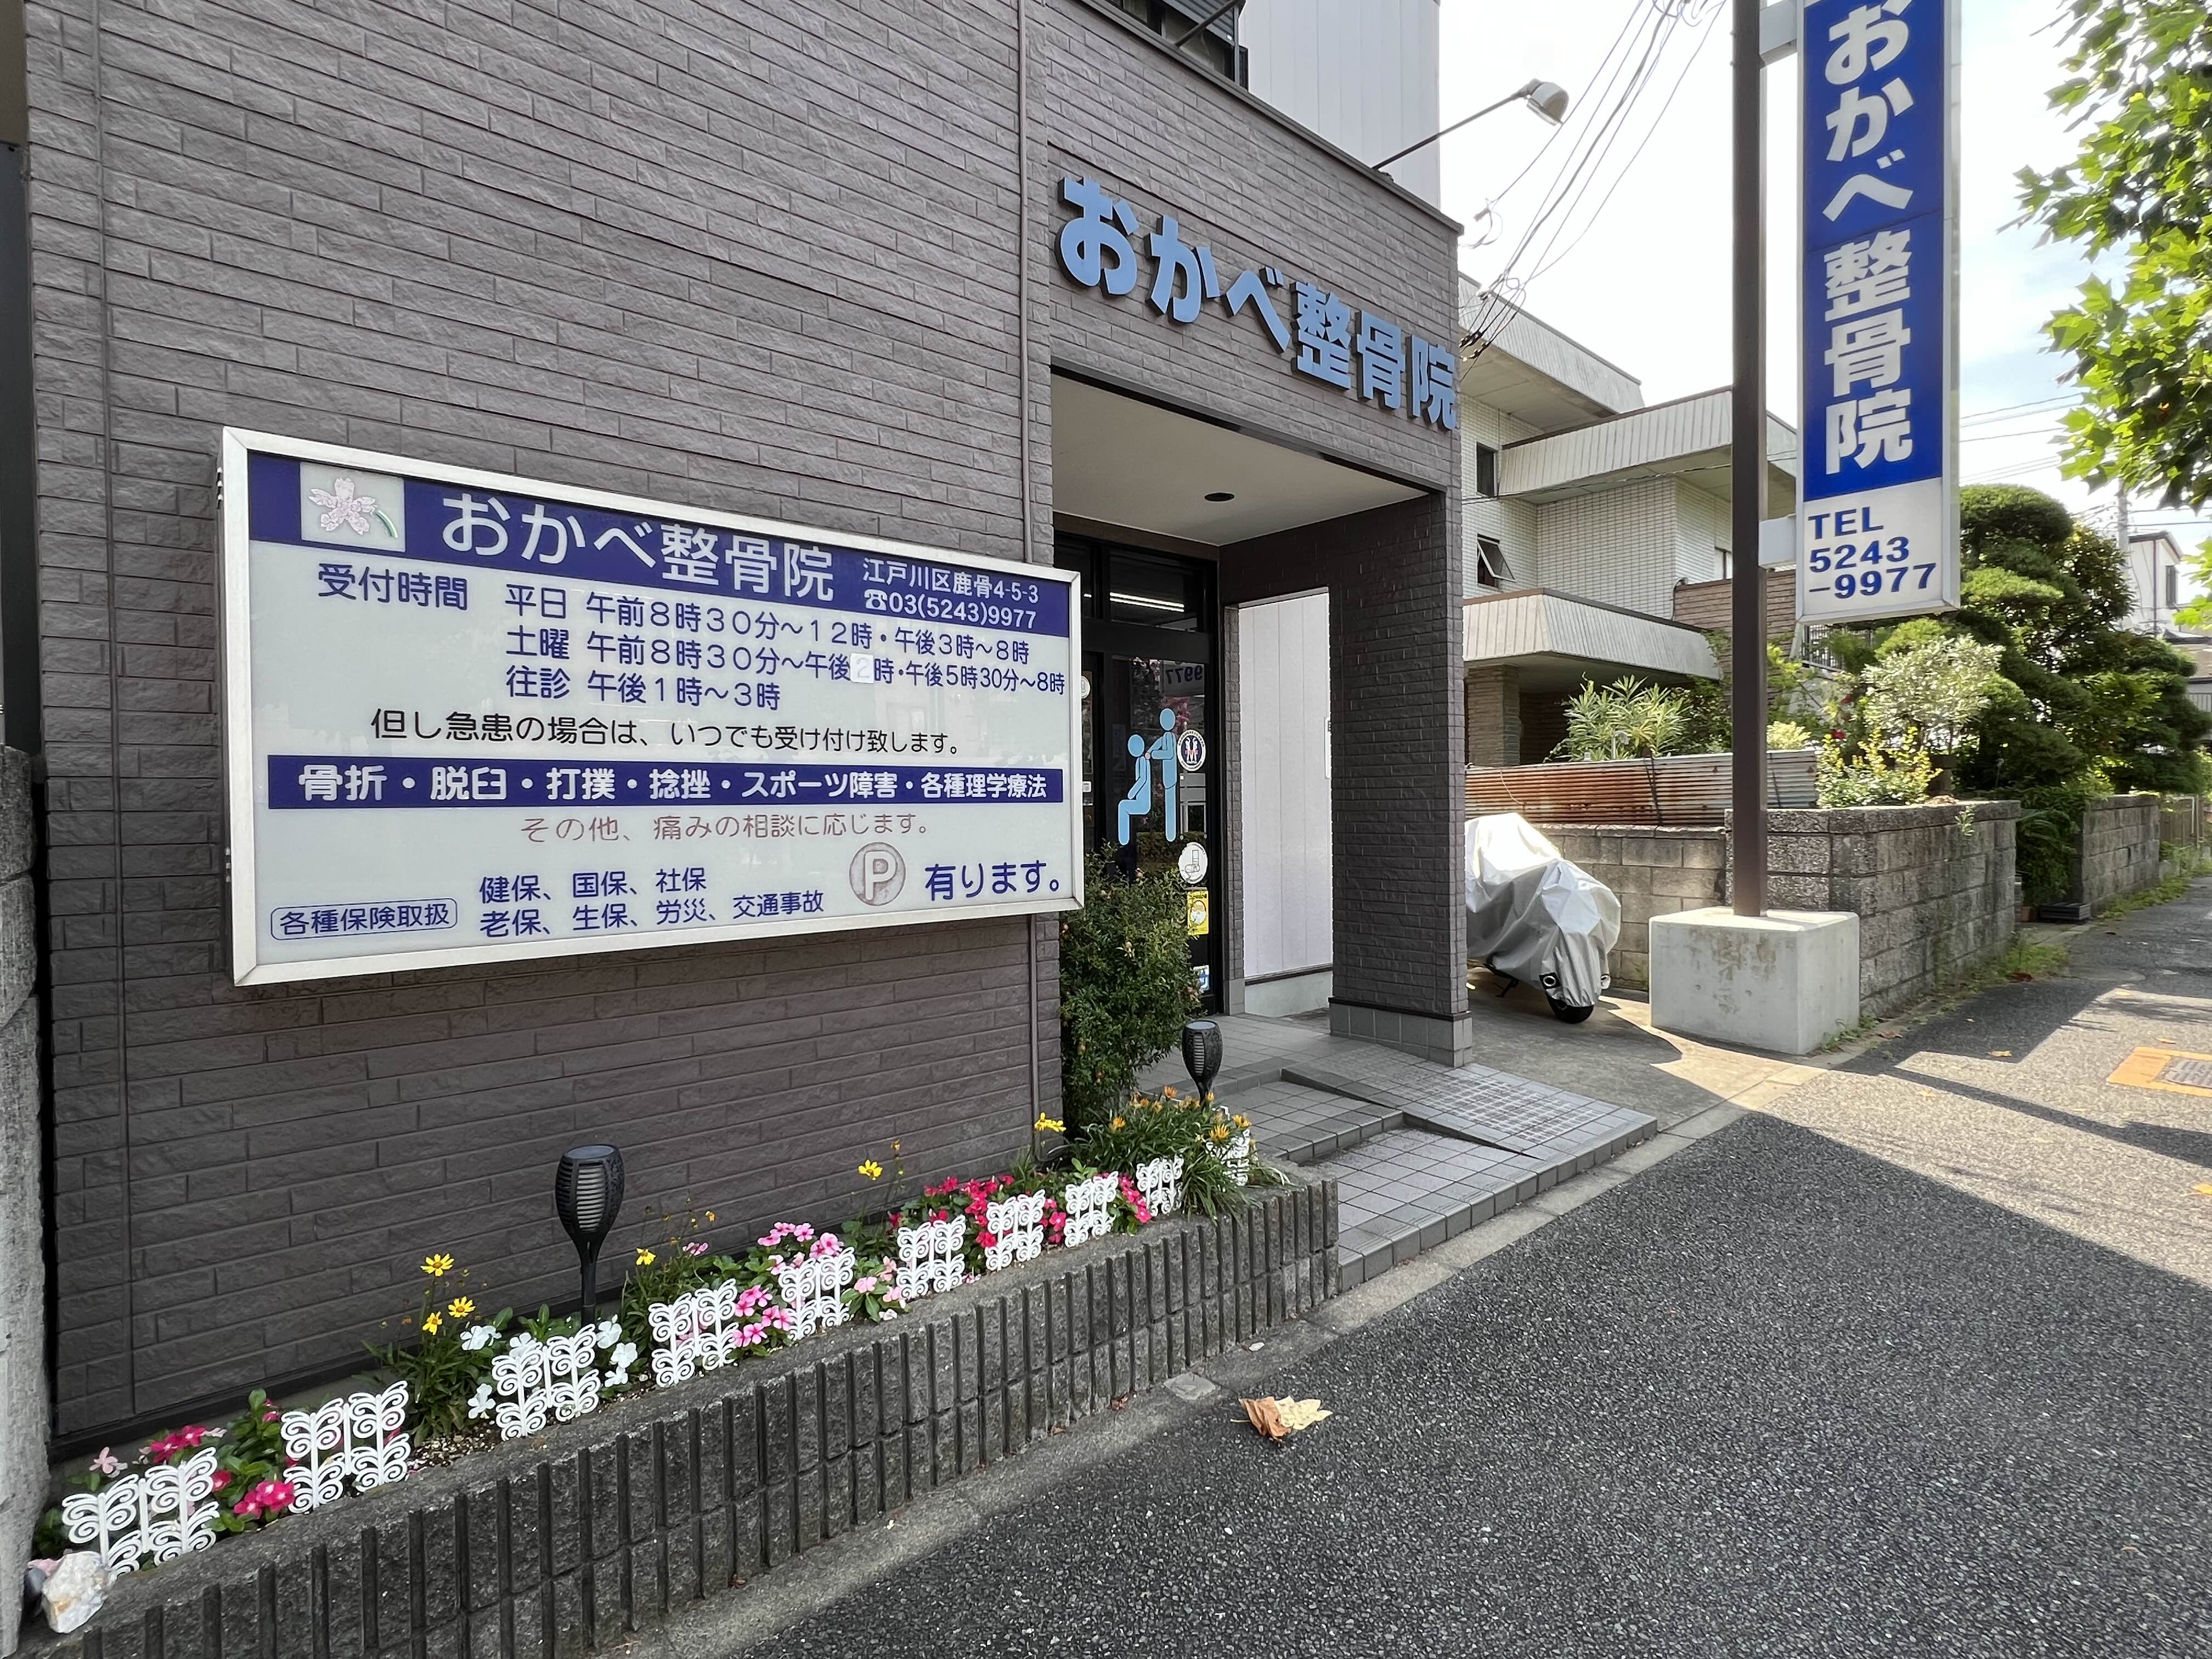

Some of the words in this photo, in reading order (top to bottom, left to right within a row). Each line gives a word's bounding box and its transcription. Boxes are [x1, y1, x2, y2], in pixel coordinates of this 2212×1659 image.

[1822, 0, 1914, 475] おかべ整骨院
[1055, 176, 1457, 431] おかべ整骨院
[1808, 506, 1883, 539] TEL
[442, 493, 833, 602] おかべ整骨院
[1809, 537, 1909, 573] 5243
[318, 563, 468, 610] 受付時間
[505, 583, 567, 619] 平日
[863, 557, 1039, 604] 江戸川区鹿骨4-5-3
[506, 625, 570, 660] 土曜
[506, 665, 570, 698] 往診
[925, 860, 1059, 901] 有ります。
[279, 903, 450, 935] 各種保険取扱
